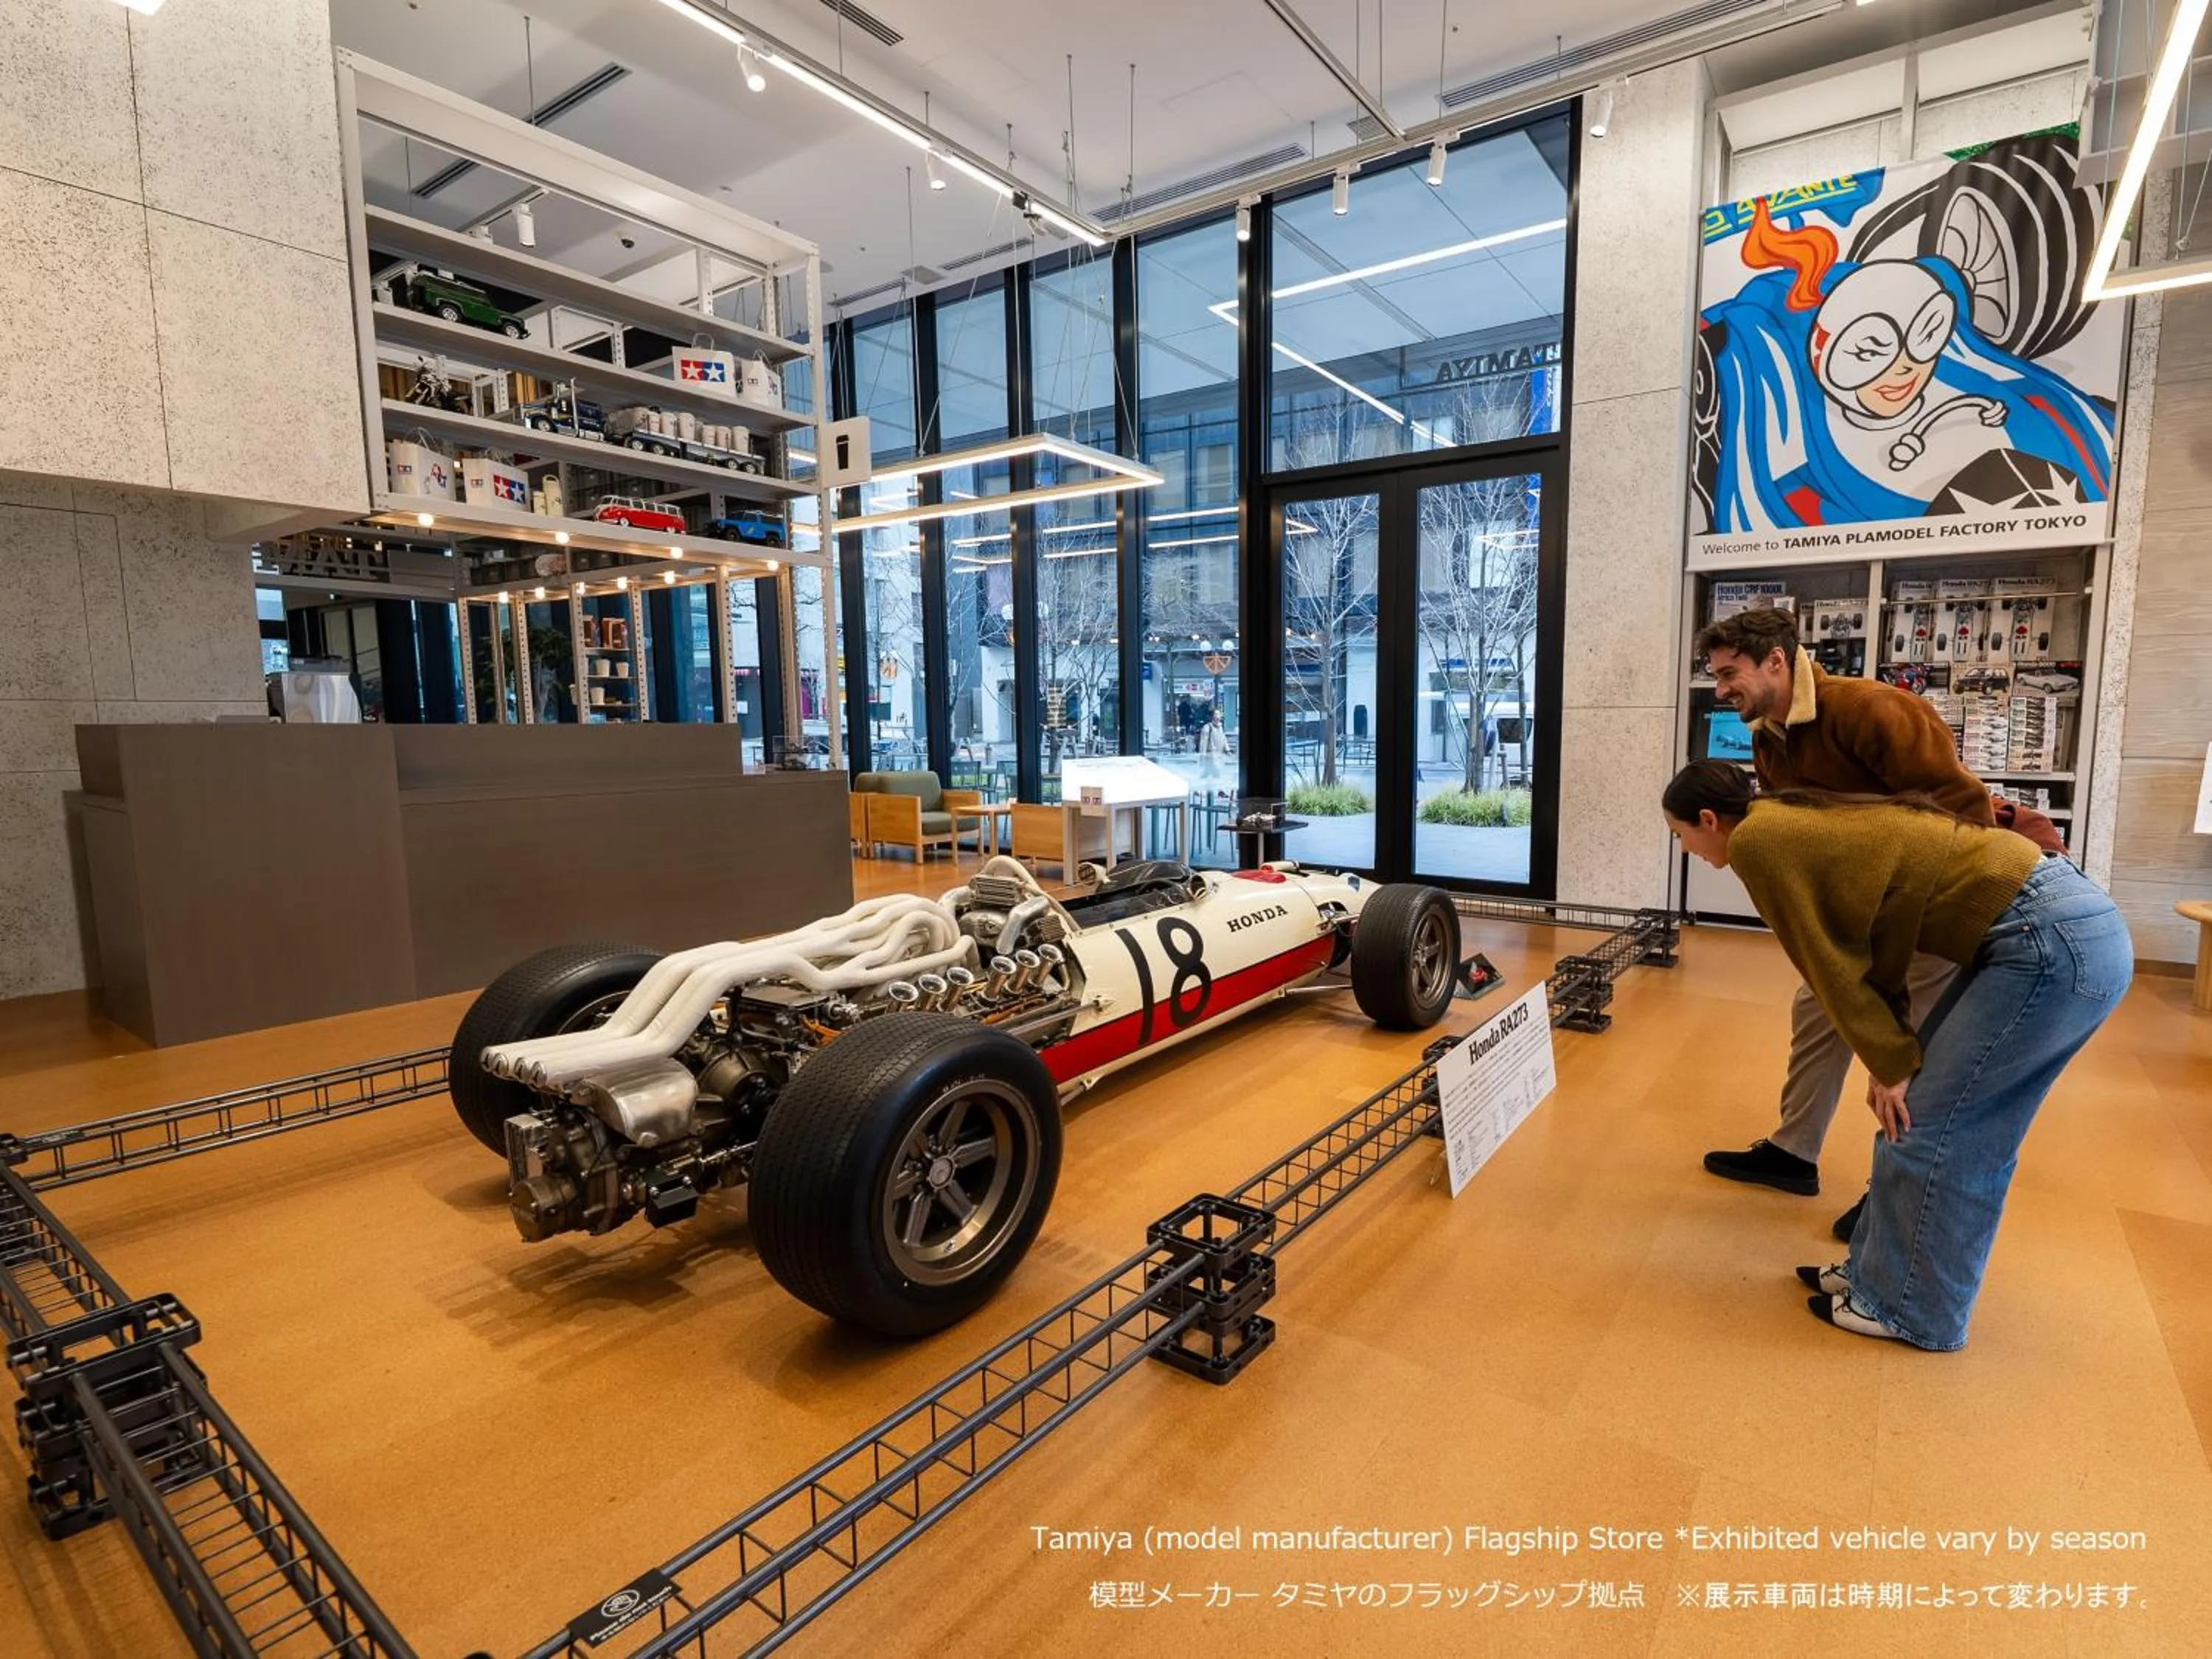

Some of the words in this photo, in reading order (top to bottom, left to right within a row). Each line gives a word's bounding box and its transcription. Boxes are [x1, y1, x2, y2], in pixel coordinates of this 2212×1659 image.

[1703, 540, 1761, 554] Welcome
[1765, 540, 1779, 551] to
[1783, 533, 1841, 549] TAMIYA
[1846, 526, 1935, 545] PLAMODEL
[1940, 520, 2019, 538] FACTORY
[2024, 515, 2087, 530] TOKYO
[1226, 904, 1289, 933] HONDA
[1114, 916, 1213, 1047] 18
[1468, 1026, 1500, 1066] Honda
[1499, 1001, 1529, 1042] RA273
